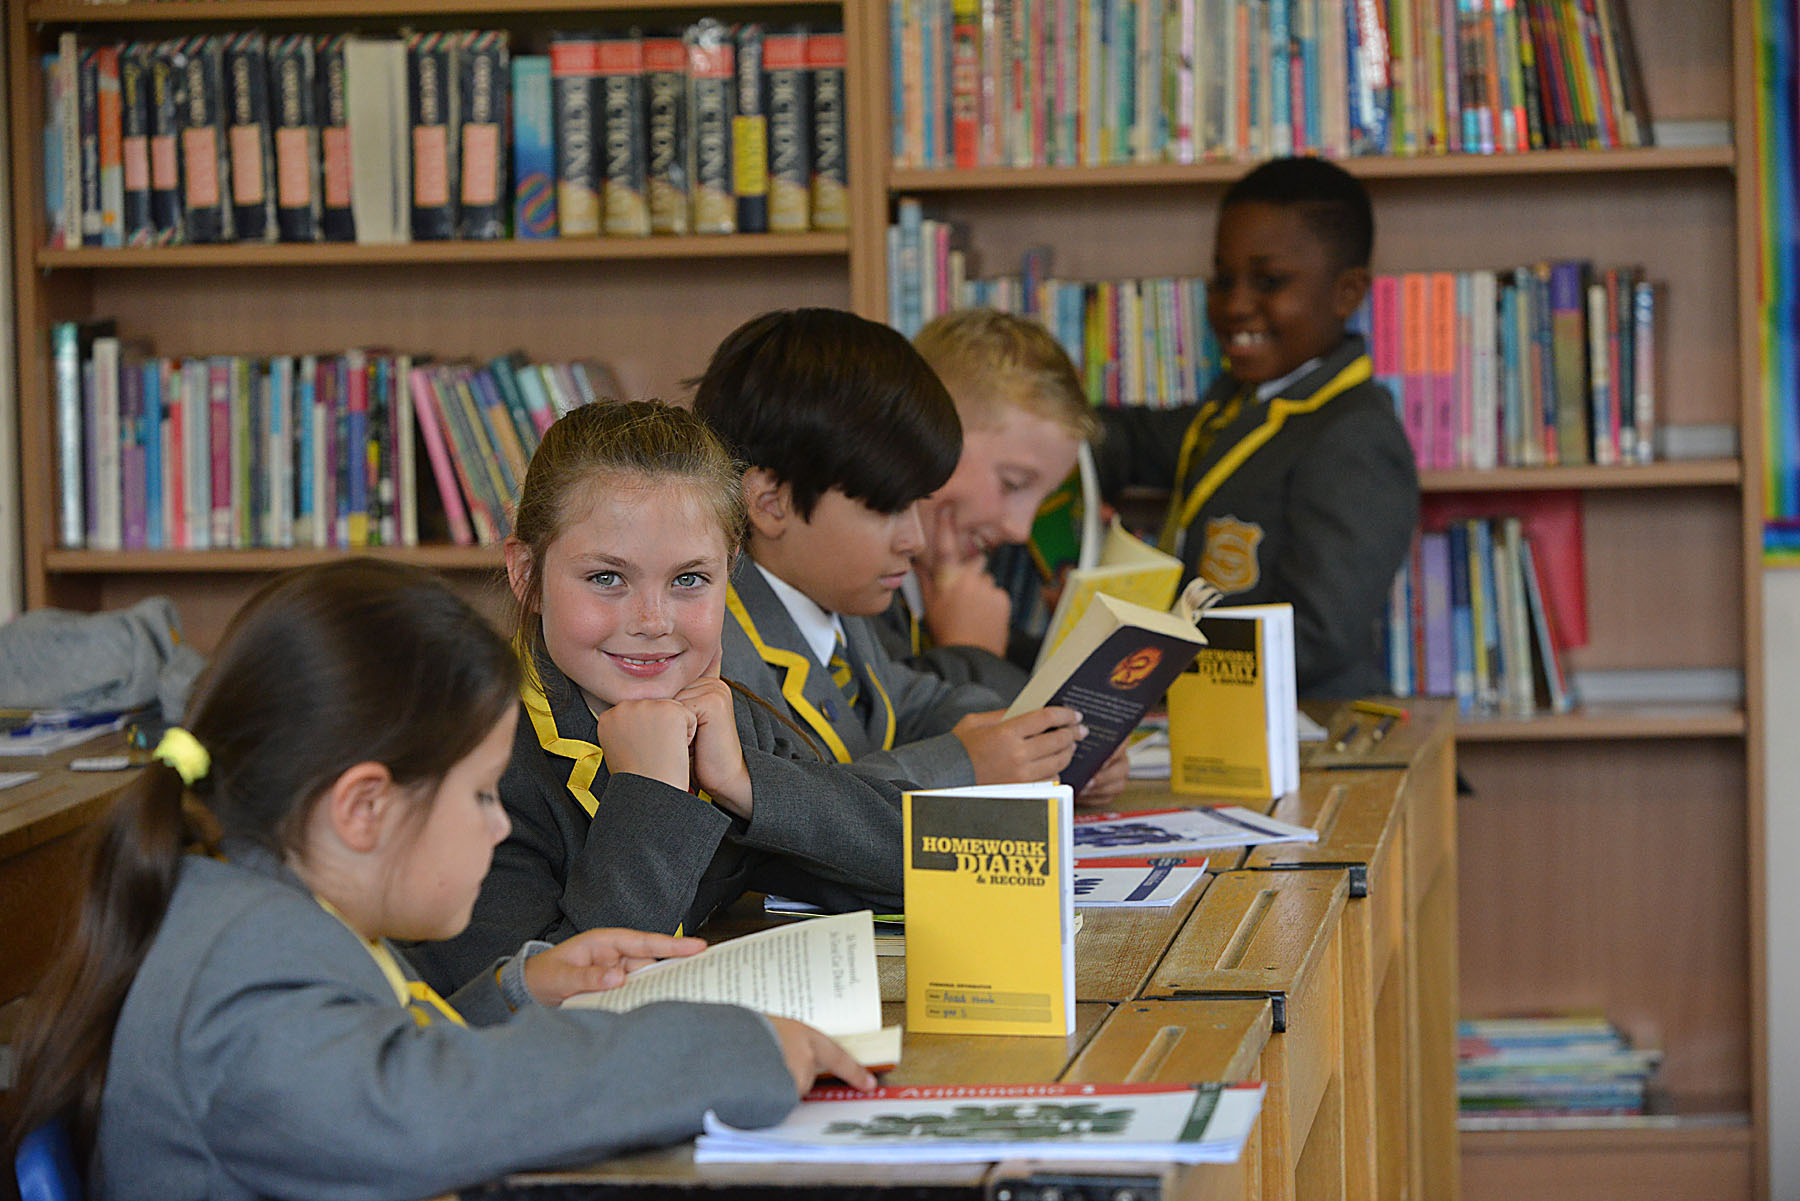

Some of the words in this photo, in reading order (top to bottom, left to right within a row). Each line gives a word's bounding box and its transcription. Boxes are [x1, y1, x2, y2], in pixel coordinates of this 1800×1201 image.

[922, 836, 1046, 857] HOMEWORK
[956, 853, 1047, 876] DIARY
[976, 874, 986, 884] &
[989, 875, 1046, 887] RECORD
